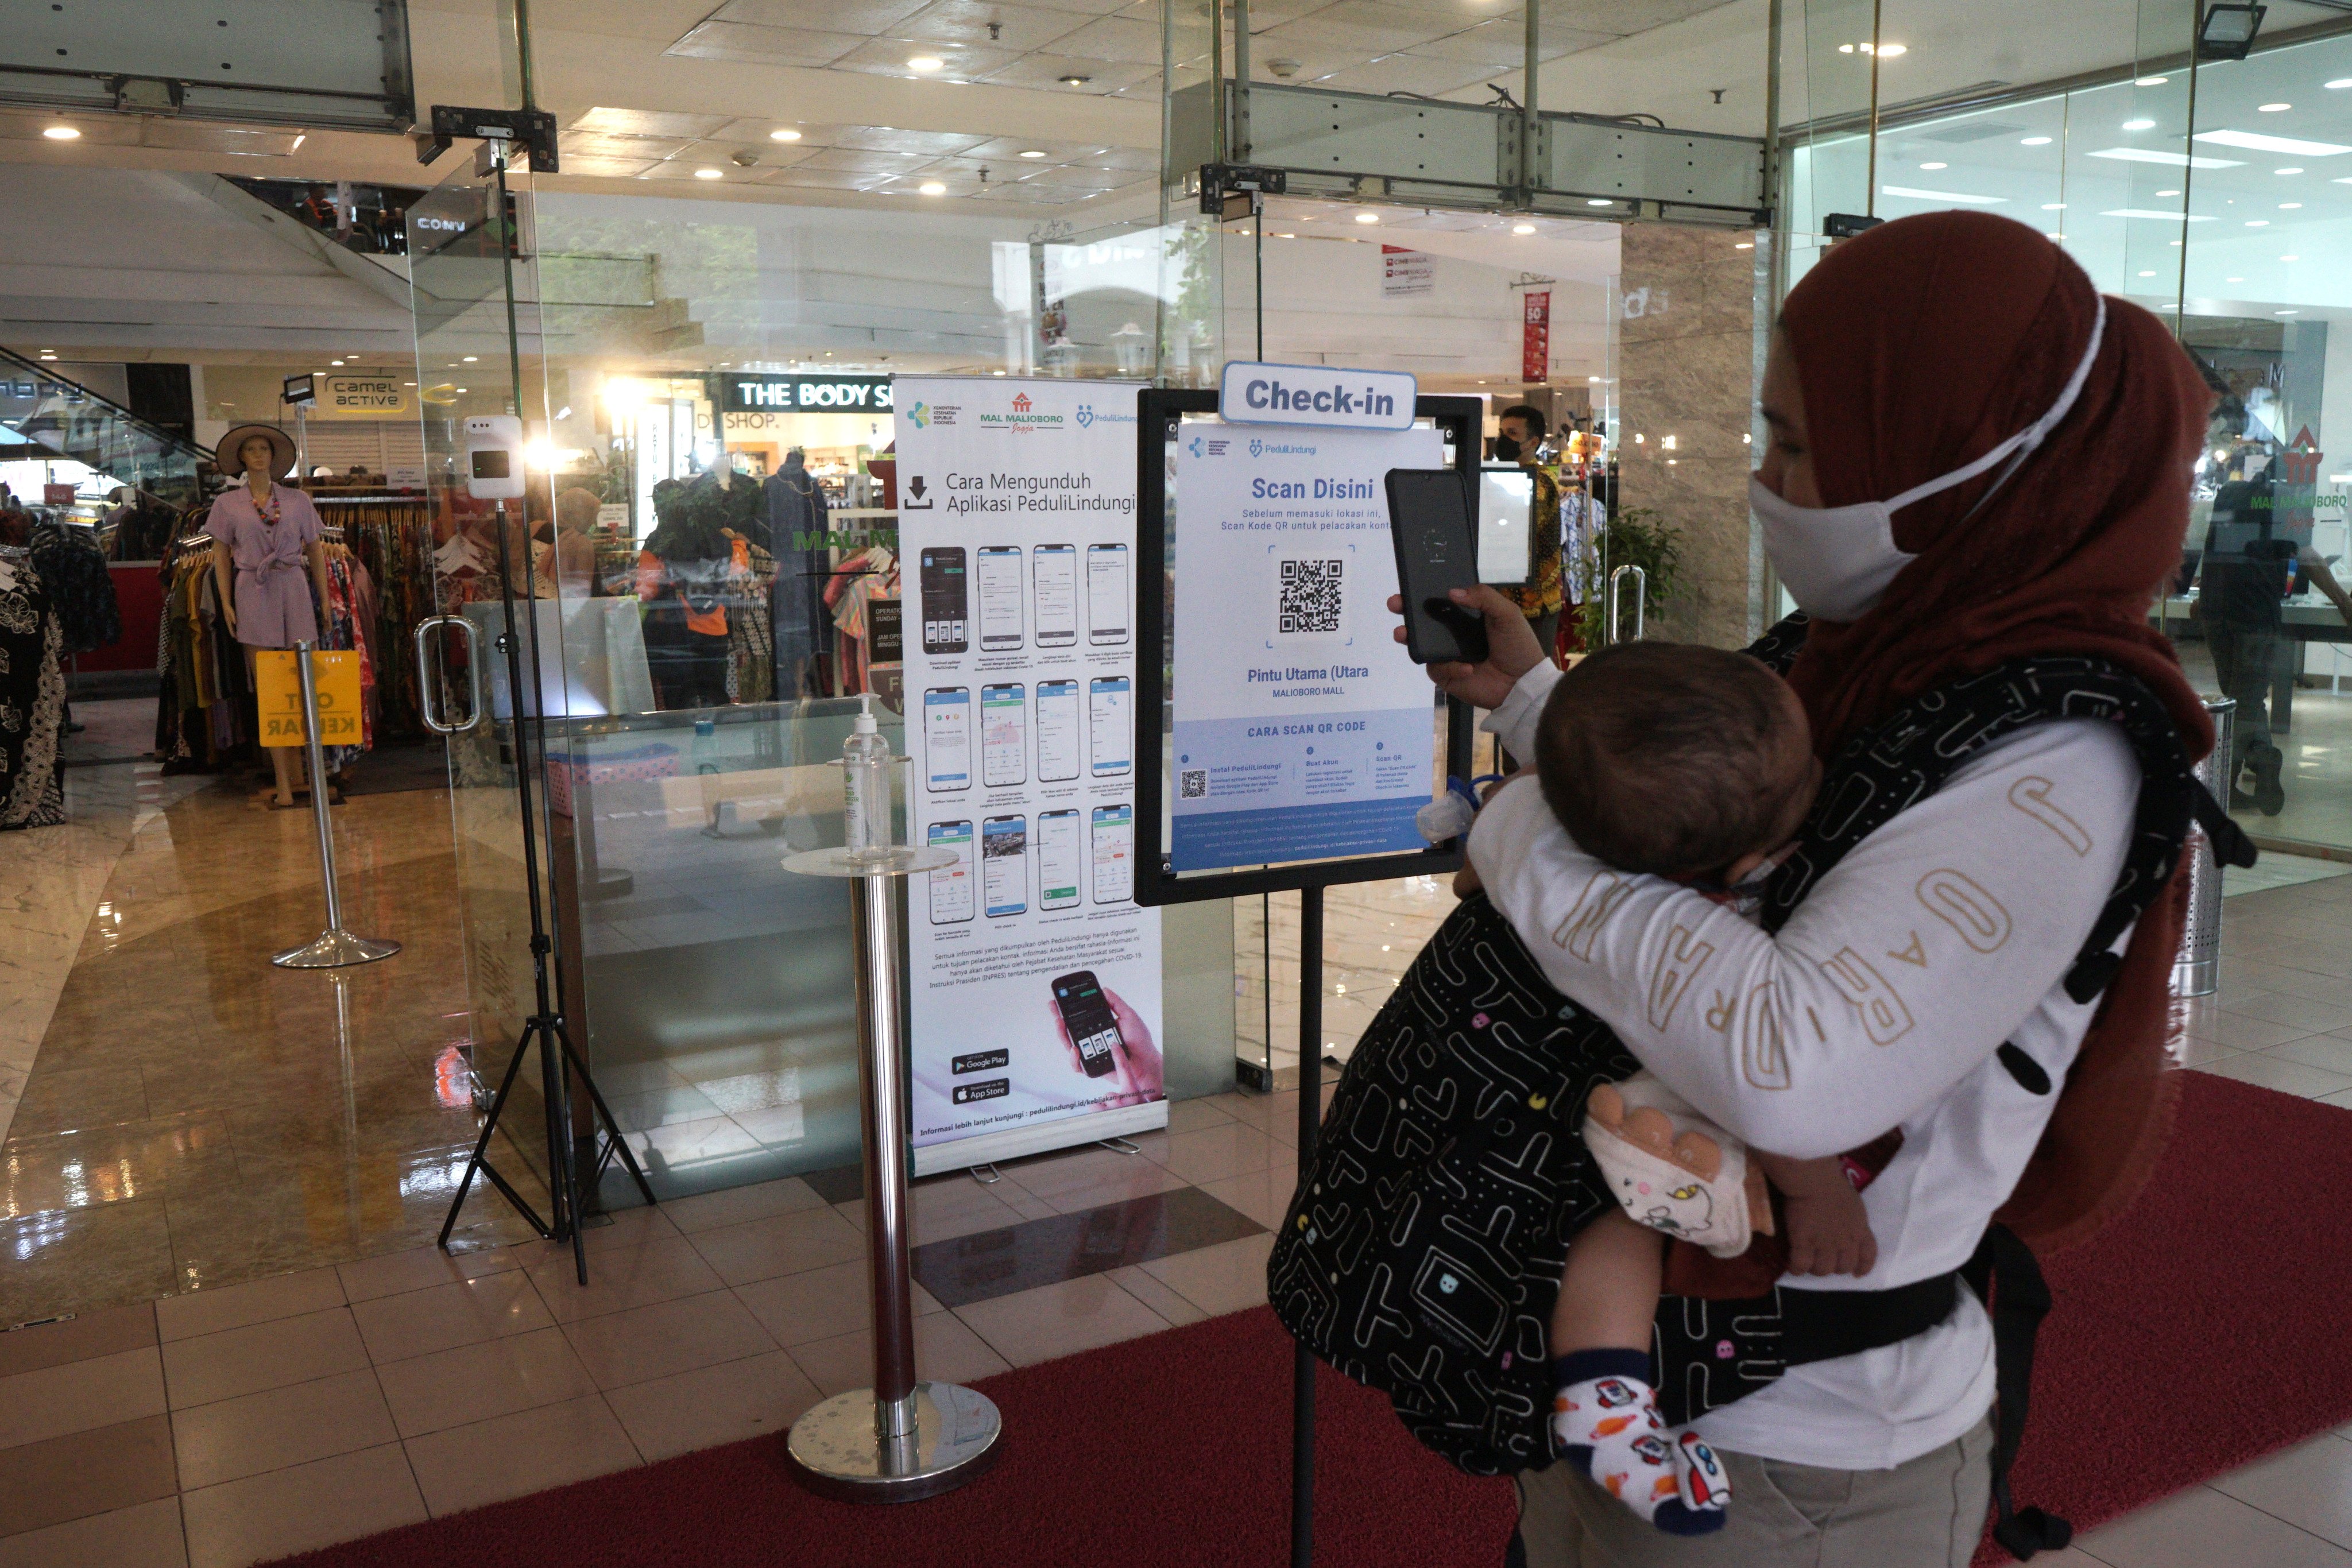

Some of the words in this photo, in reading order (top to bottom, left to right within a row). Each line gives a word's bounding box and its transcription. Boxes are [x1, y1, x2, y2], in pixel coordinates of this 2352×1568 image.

[738, 383, 791, 405] THE
[799, 384, 869, 406] BODY
[874, 386, 895, 407] S
[1245, 379, 1394, 416] Check-in
[980, 414, 1003, 422] MAL
[1095, 414, 1138, 423] PeduliLindung
[1266, 444, 1316, 455] PeduliLindungi
[946, 473, 983, 490] Cara
[991, 473, 1091, 494] Mengunduh
[1252, 478, 1306, 500] Scan
[1314, 479, 1374, 499] Disini
[946, 495, 1011, 516] Aplikasi
[1018, 494, 1135, 514] PeduliLindungi
[1243, 509, 1283, 518] Sebelum
[1286, 509, 1334, 518] memasuki
[1336, 509, 1365, 518] lokasi
[1367, 509, 1380, 518] ini,
[1221, 521, 1245, 531] Scan
[1248, 521, 1271, 530] Kode
[1274, 521, 1289, 531] QR
[1291, 521, 1317, 530] untuk
[1320, 521, 1367, 533] pelacakan
[1370, 521, 1391, 530] kont
[792, 531, 859, 551] MAL
[869, 529, 900, 548] M
[1248, 668, 1282, 682] Pintu
[1286, 667, 1327, 680] Utama
[1330, 665, 1369, 682] (Utara
[1272, 688, 1320, 698] MALIOBORO
[1322, 687, 1344, 695] MALL
[1248, 727, 1279, 737] CARA
[1283, 725, 1314, 735] SCAN
[1318, 723, 1333, 734] QR
[1336, 721, 1366, 731] CODE
[1232, 763, 1281, 772] PeduliLindungi
[956, 948, 983, 957] informasi
[1000, 942, 1036, 951] dikumpulkan
[1051, 934, 1091, 944] PeduliLindungi
[1110, 927, 1138, 936] digunakan
[950, 960, 969, 969] tujuan
[970, 956, 999, 965] pelacakan
[1065, 943, 1086, 951] bersifat
[950, 969, 968, 977] hanya
[984, 963, 1010, 972] diketahui
[1026, 958, 1046, 966] Pejabat
[1047, 954, 1076, 963] Kesehatan
[1077, 950, 1108, 958] Masyarakat
[930, 980, 954, 989] Instruksi
[1008, 969, 1030, 978] tentang
[1031, 964, 1068, 974] pengendalian
[1081, 957, 1114, 967] pencegahan
[966, 1059, 991, 1068] Google
[991, 1056, 1007, 1064] Play
[970, 1091, 985, 1099] App
[986, 1087, 1005, 1096] Store
[920, 1124, 953, 1136] Informasi
[955, 1121, 972, 1129] lebih
[973, 1117, 993, 1126] lanjut
[995, 1111, 1024, 1121] kunjungi
